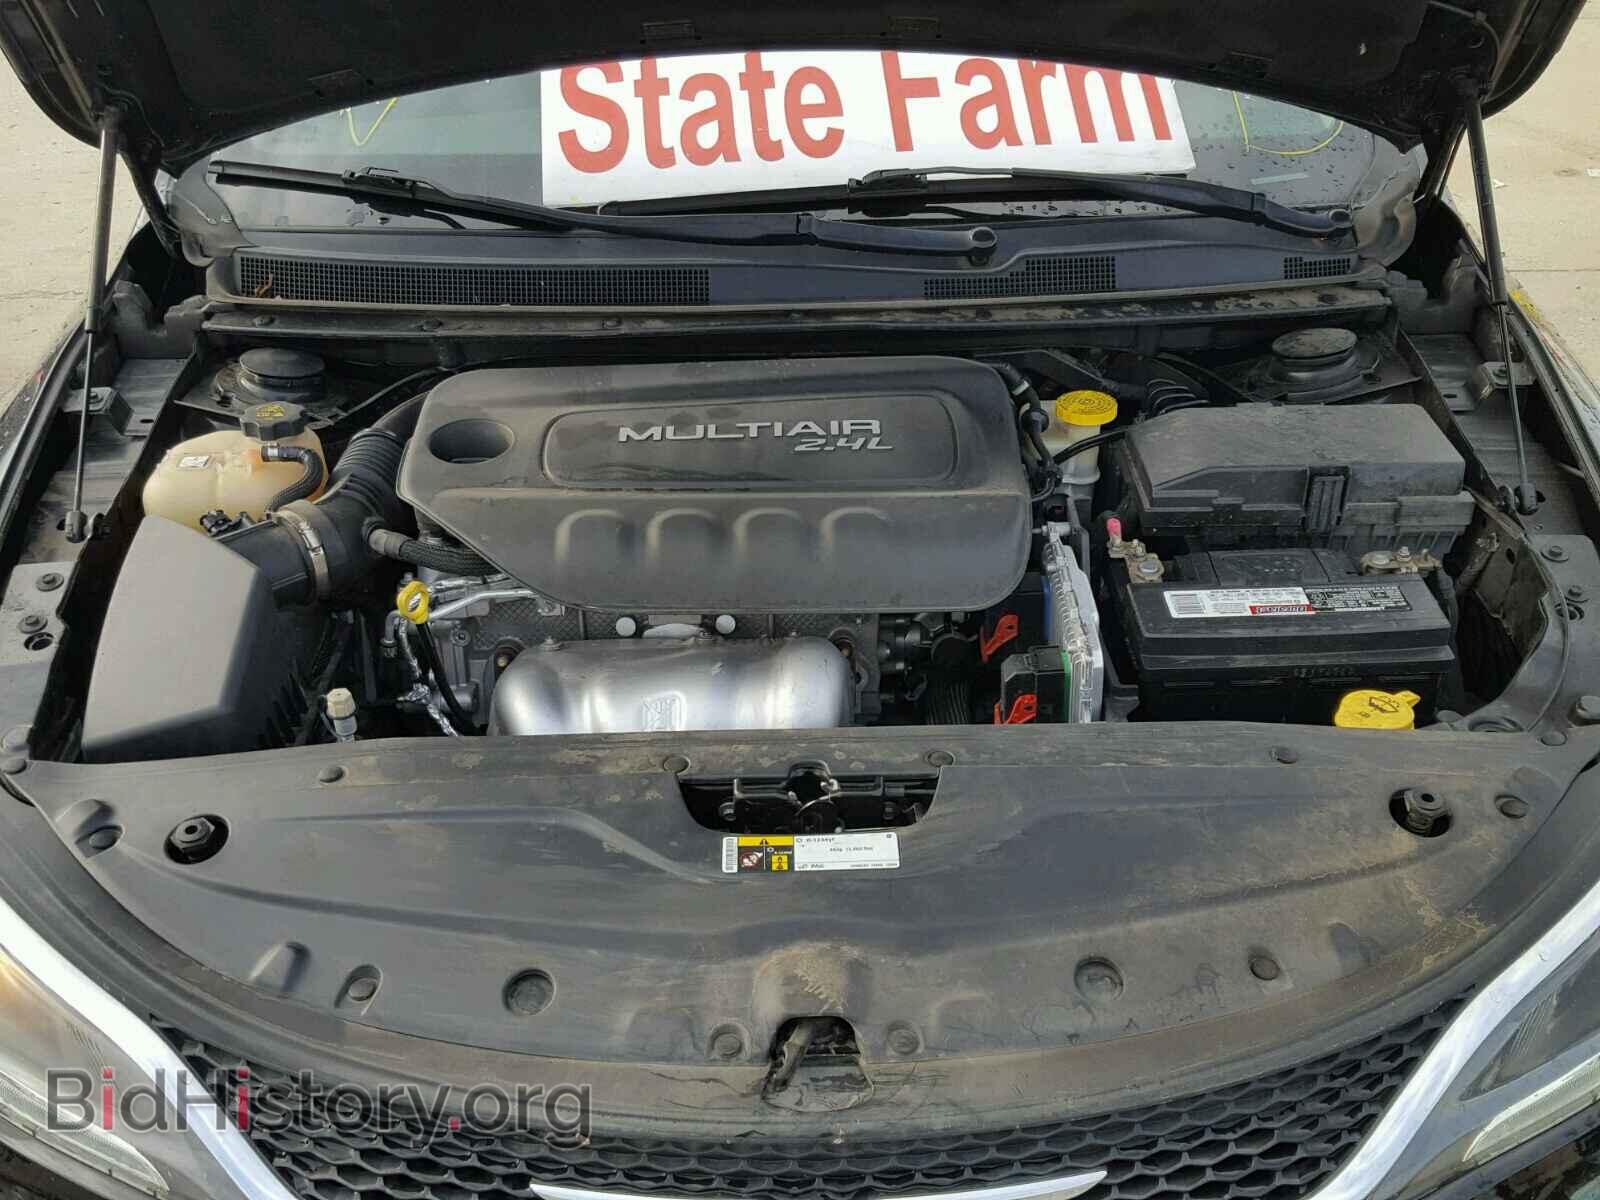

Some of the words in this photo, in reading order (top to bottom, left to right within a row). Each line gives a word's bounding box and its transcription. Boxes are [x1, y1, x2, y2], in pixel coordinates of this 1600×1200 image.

[558, 51, 846, 173] State
[880, 50, 1172, 151] Farm
[618, 419, 881, 442] MULTIAIR
[794, 437, 893, 451] 2.4L
